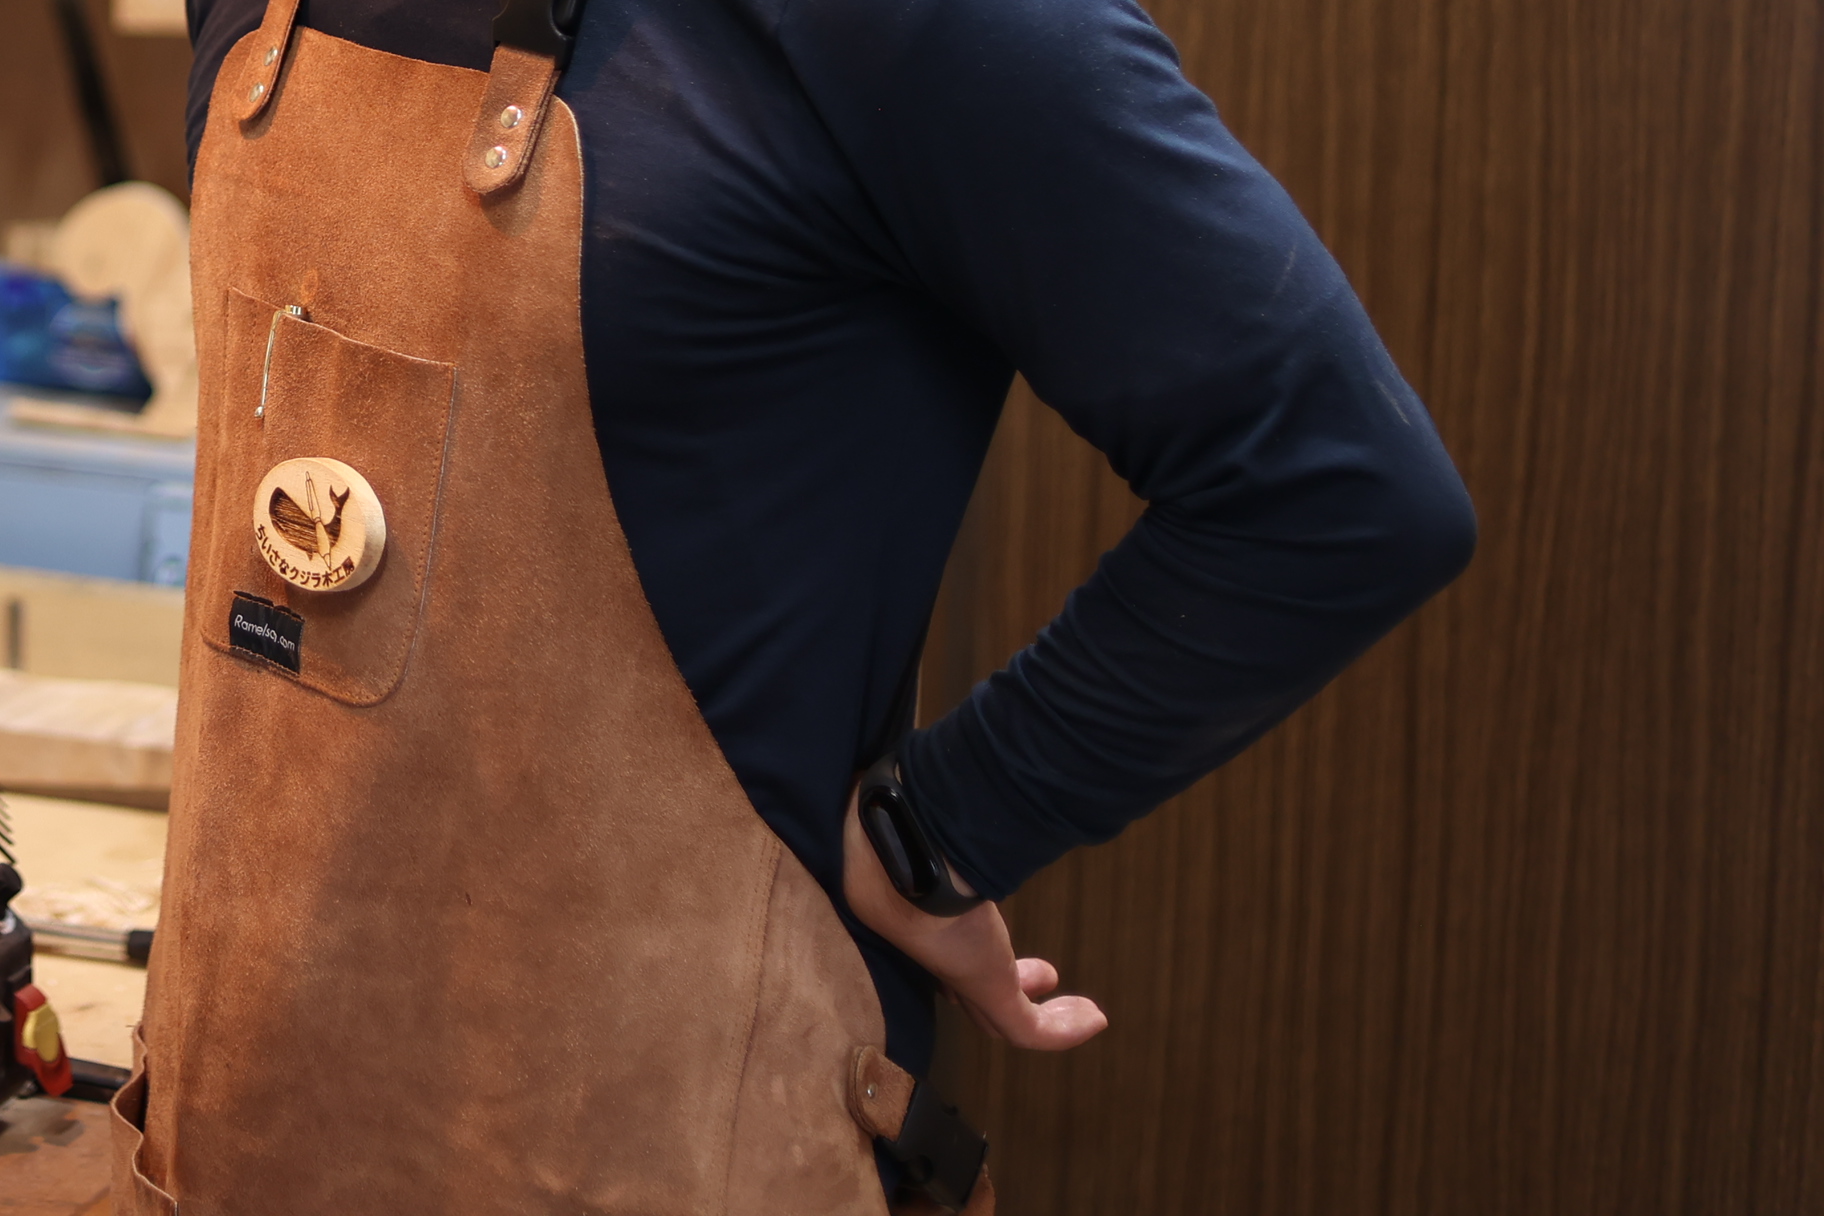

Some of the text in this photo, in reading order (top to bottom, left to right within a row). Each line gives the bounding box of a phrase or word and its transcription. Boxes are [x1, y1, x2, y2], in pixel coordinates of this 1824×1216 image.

[256, 524, 355, 588] ちいさなクジラ木工房
